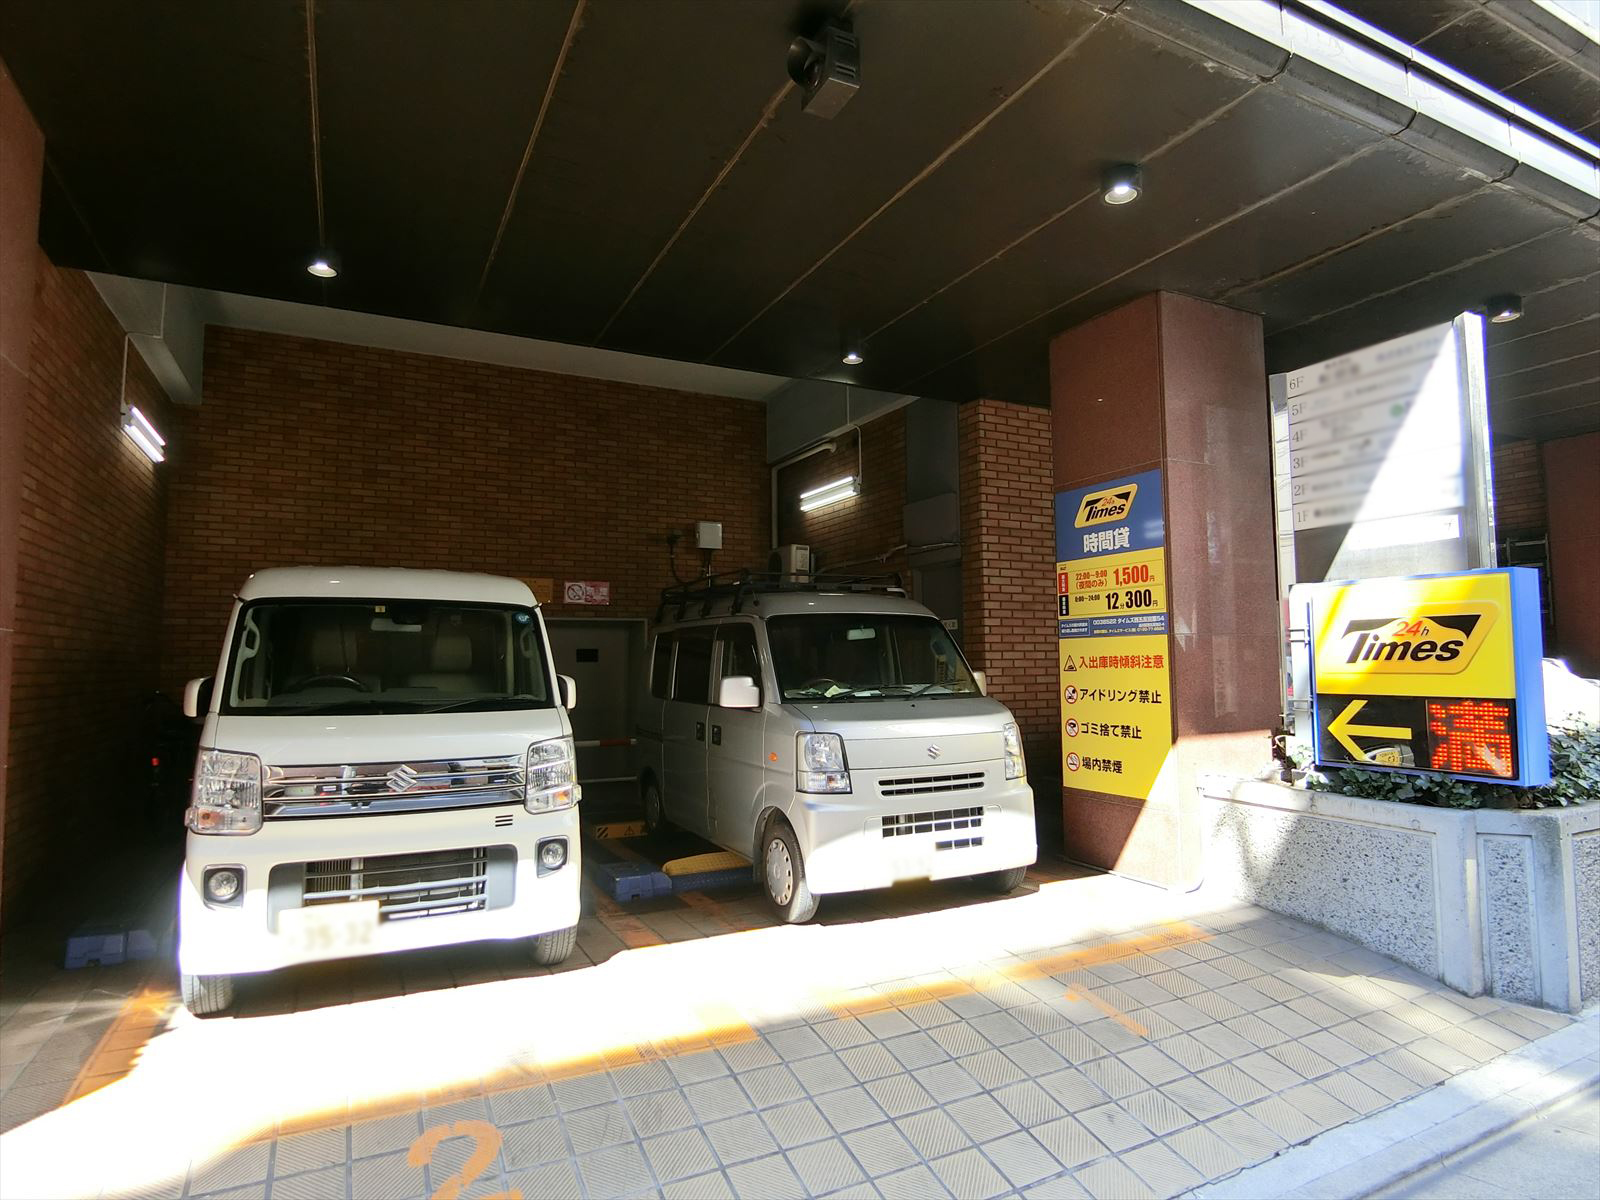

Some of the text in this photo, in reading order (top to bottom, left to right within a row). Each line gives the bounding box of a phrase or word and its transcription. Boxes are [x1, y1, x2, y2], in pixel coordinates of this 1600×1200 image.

[1289, 376, 1304, 390] 6F
[1291, 403, 1304, 416] 5F
[1292, 428, 1307, 442] 4F
[1293, 456, 1308, 470] 3F
[1293, 483, 1308, 497] 2F
[1083, 498, 1127, 522] Times
[1296, 510, 1309, 523] 1F
[1083, 527, 1130, 553] 時間貸
[1392, 620, 1430, 638] 24h
[1342, 627, 1464, 664] Times
[1079, 655, 1164, 669] 入出庫時傾斜注意
[1079, 688, 1162, 704] アイドリング禁止
[1080, 722, 1143, 739] ゴミ捨て禁止
[1429, 701, 1513, 778] 満
[1082, 756, 1123, 774] 場内禁煙
